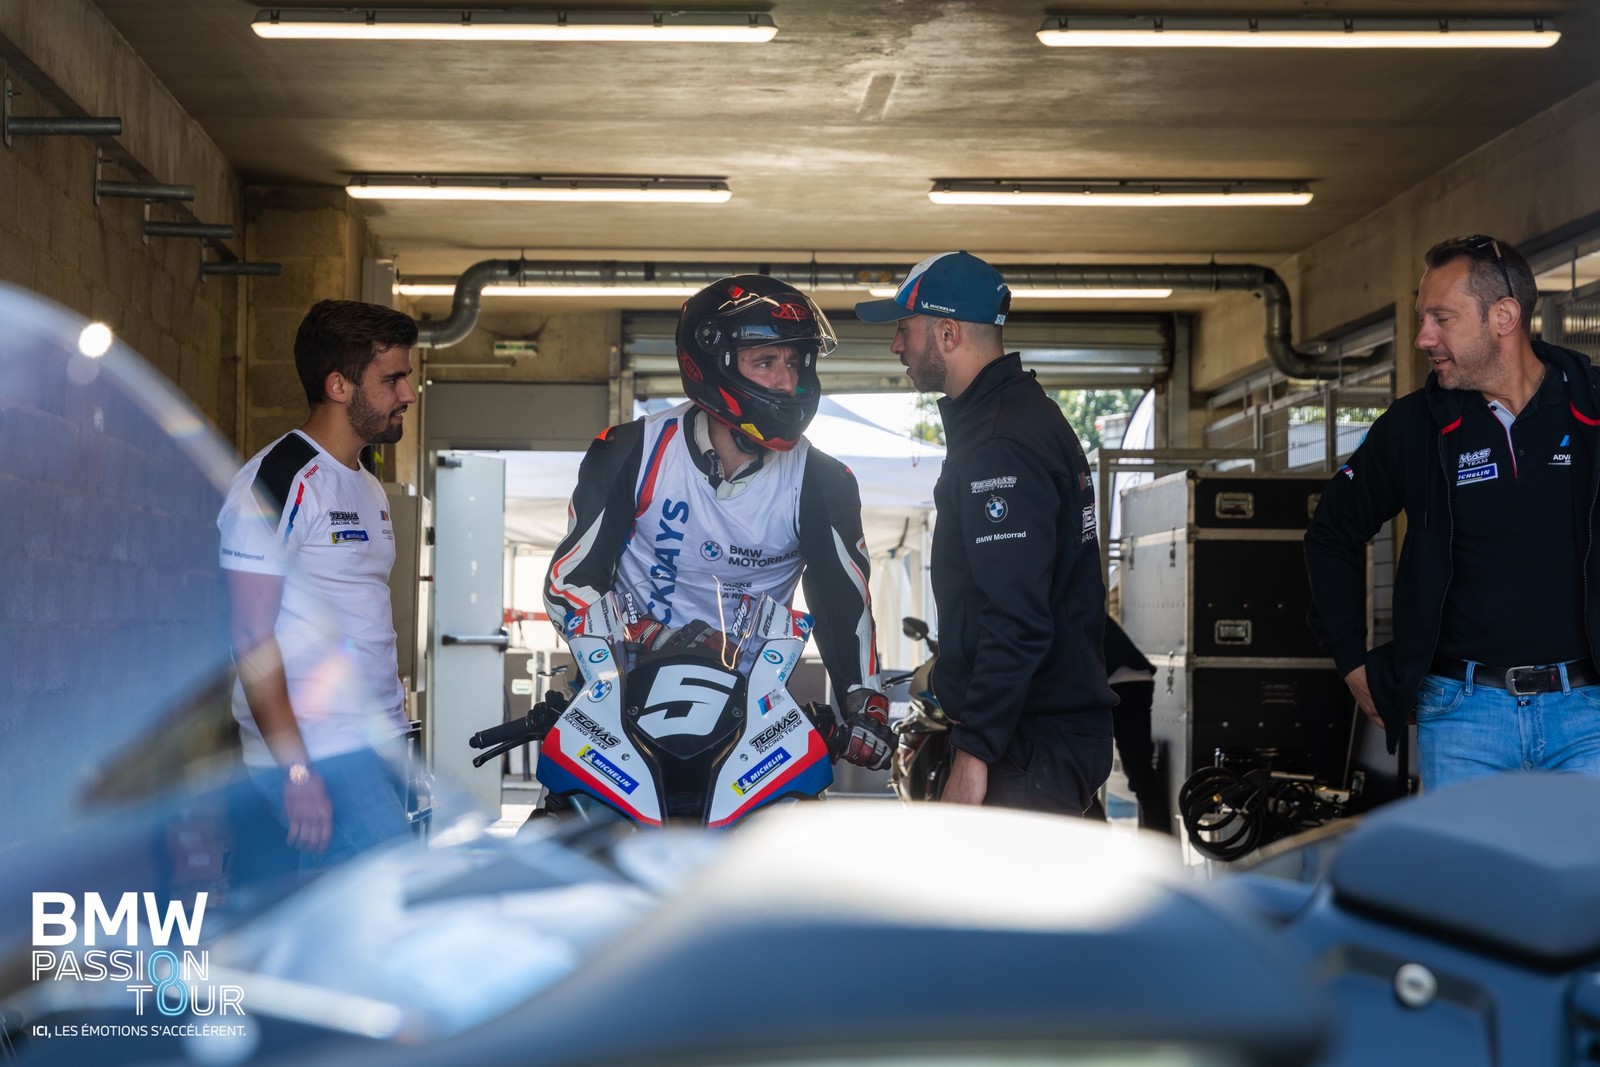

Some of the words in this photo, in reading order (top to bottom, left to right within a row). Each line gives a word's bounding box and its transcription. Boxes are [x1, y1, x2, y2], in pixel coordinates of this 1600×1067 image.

[729, 544, 763, 558] BMW
[975, 535, 993, 544] BMW
[993, 531, 1027, 540] Motorrad
[728, 550, 799, 568] MOTORRAD
[624, 592, 638, 625] Puig
[732, 602, 748, 637] Puig
[637, 663, 738, 740] 5
[563, 714, 588, 737] RACING
[588, 735, 608, 751] TEAM
[567, 708, 621, 748] TECMAS
[749, 708, 801, 752] TECMAS
[759, 733, 784, 755] RACING
[784, 719, 803, 735] TEAM
[594, 759, 632, 788] MICHELIN
[750, 752, 784, 782] MICHELIN
